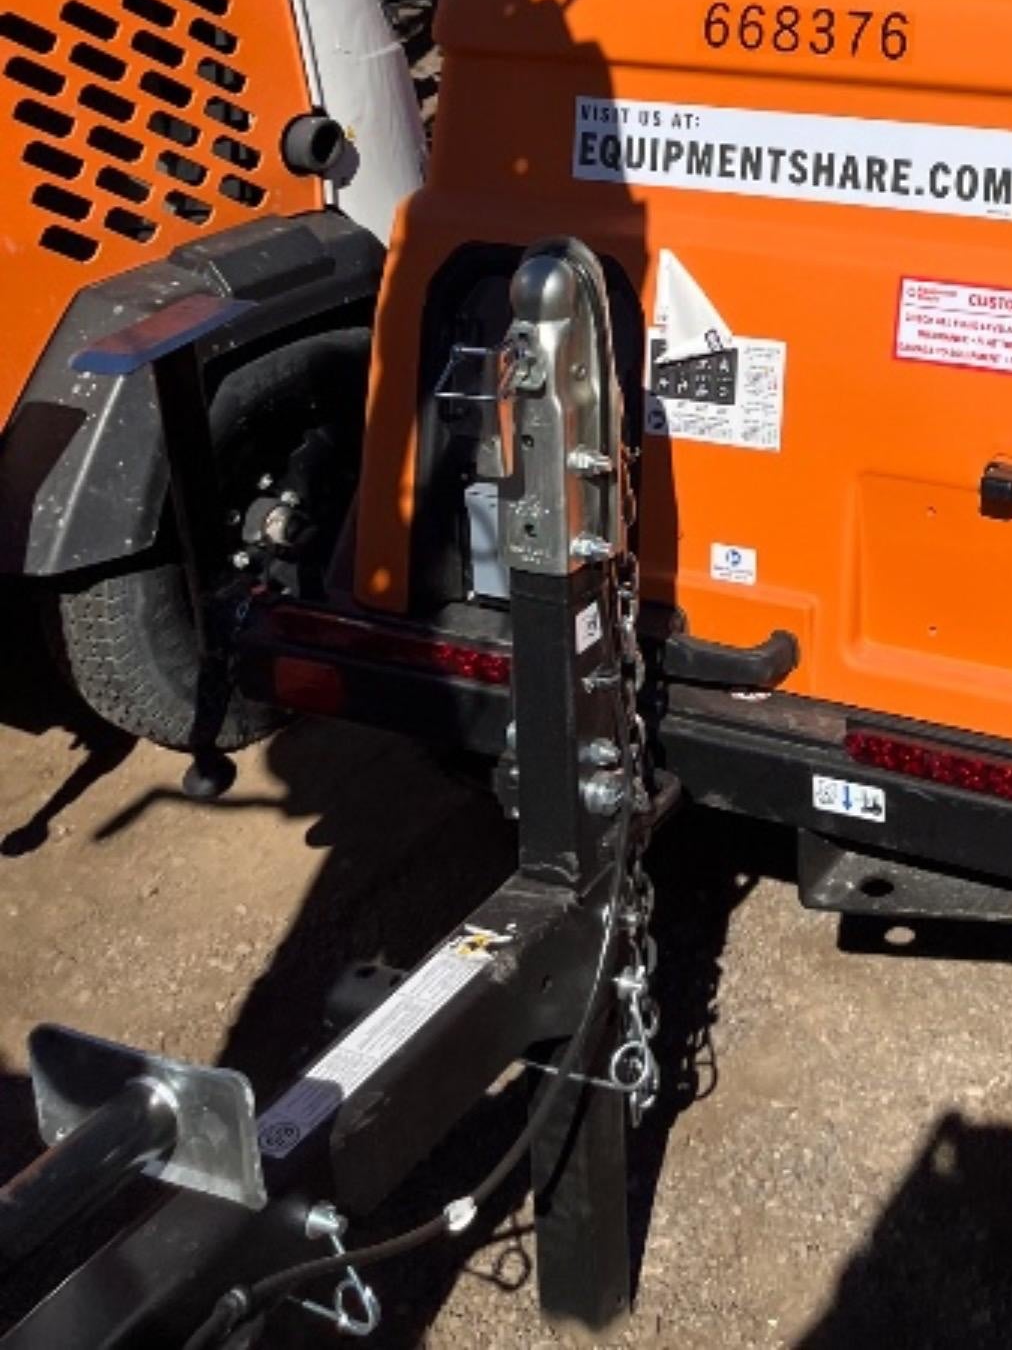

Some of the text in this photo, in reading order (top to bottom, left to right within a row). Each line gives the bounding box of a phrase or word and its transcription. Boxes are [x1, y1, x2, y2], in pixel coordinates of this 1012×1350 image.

[704, 1, 910, 60] 668376
[580, 104, 700, 129] VISIT US AT:
